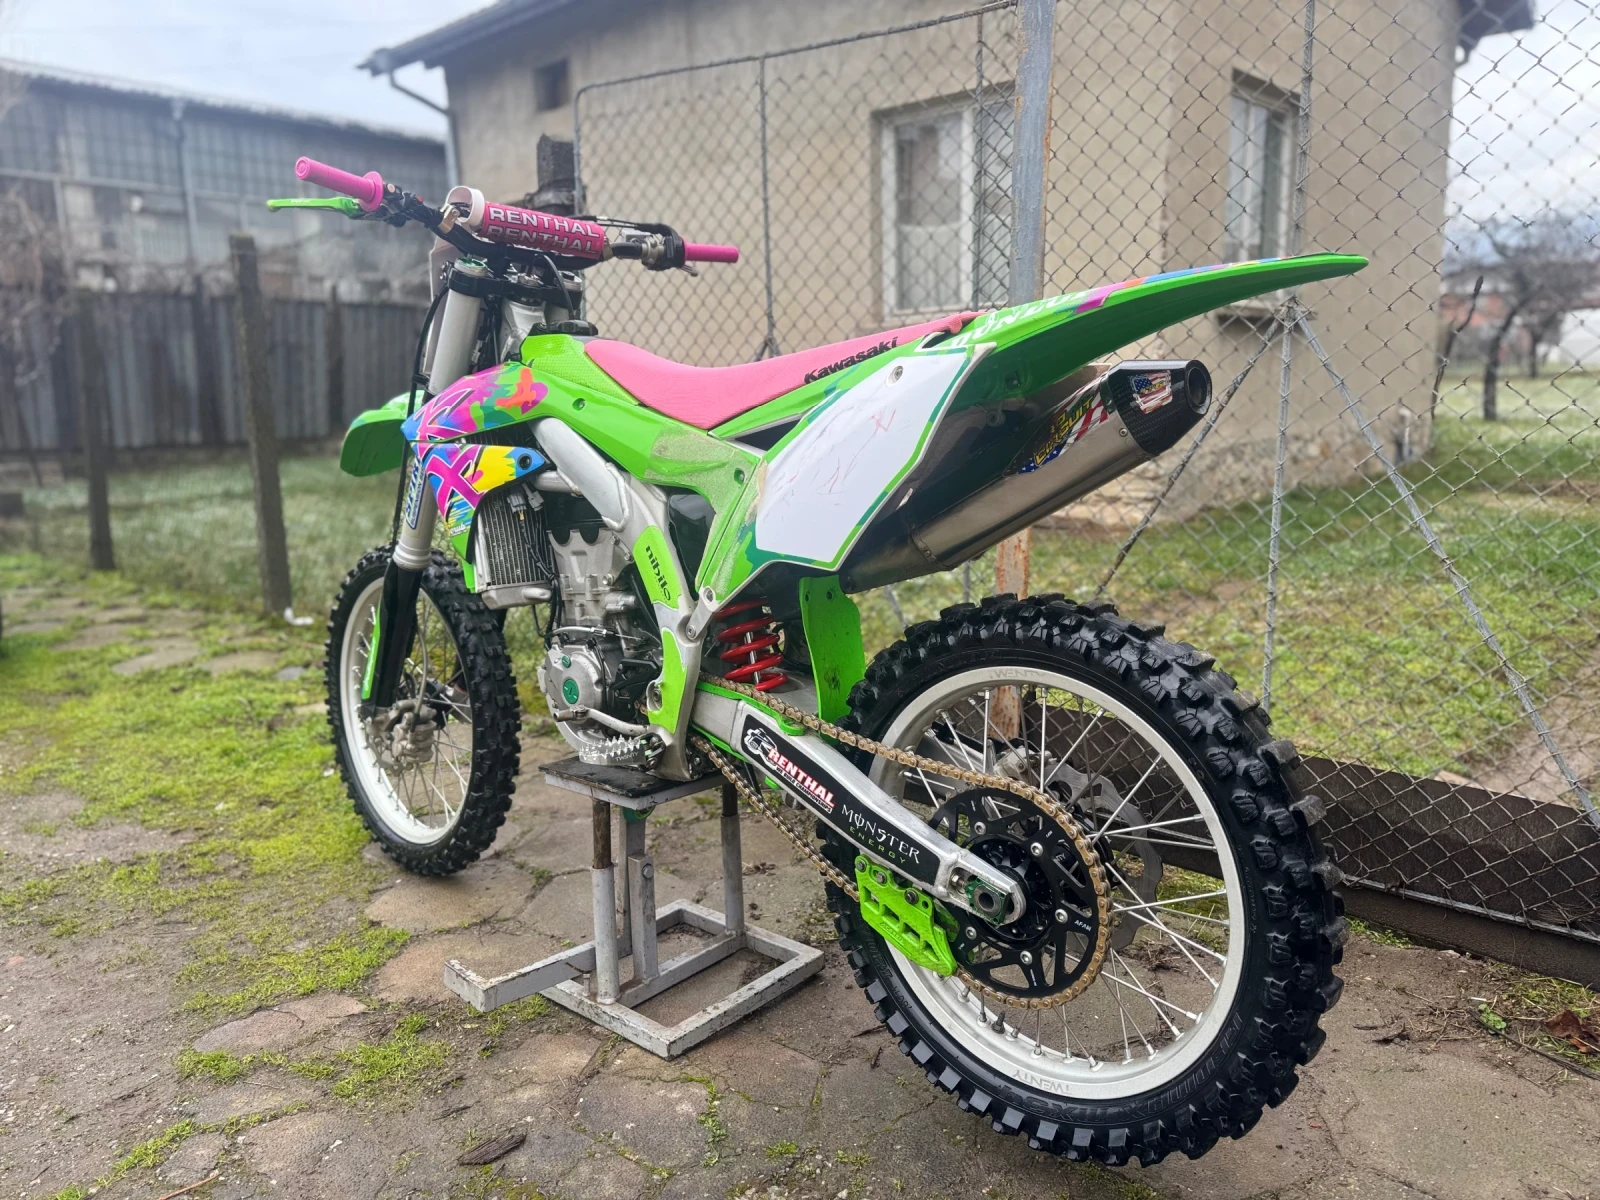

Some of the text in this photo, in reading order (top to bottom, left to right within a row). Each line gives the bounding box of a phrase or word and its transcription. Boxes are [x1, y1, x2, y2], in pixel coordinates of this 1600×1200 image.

[486, 225, 598, 254] RENTHAL
[488, 207, 600, 238] RENTHAL
[803, 336, 898, 385] Kawasaki
[767, 748, 835, 808] RENTHAL
[795, 782, 831, 812] CHAMPIONSHIPS
[841, 804, 920, 864] MONSTER
[849, 825, 906, 864] ENERGY
[1014, 1069, 1073, 1095] TWENTY
